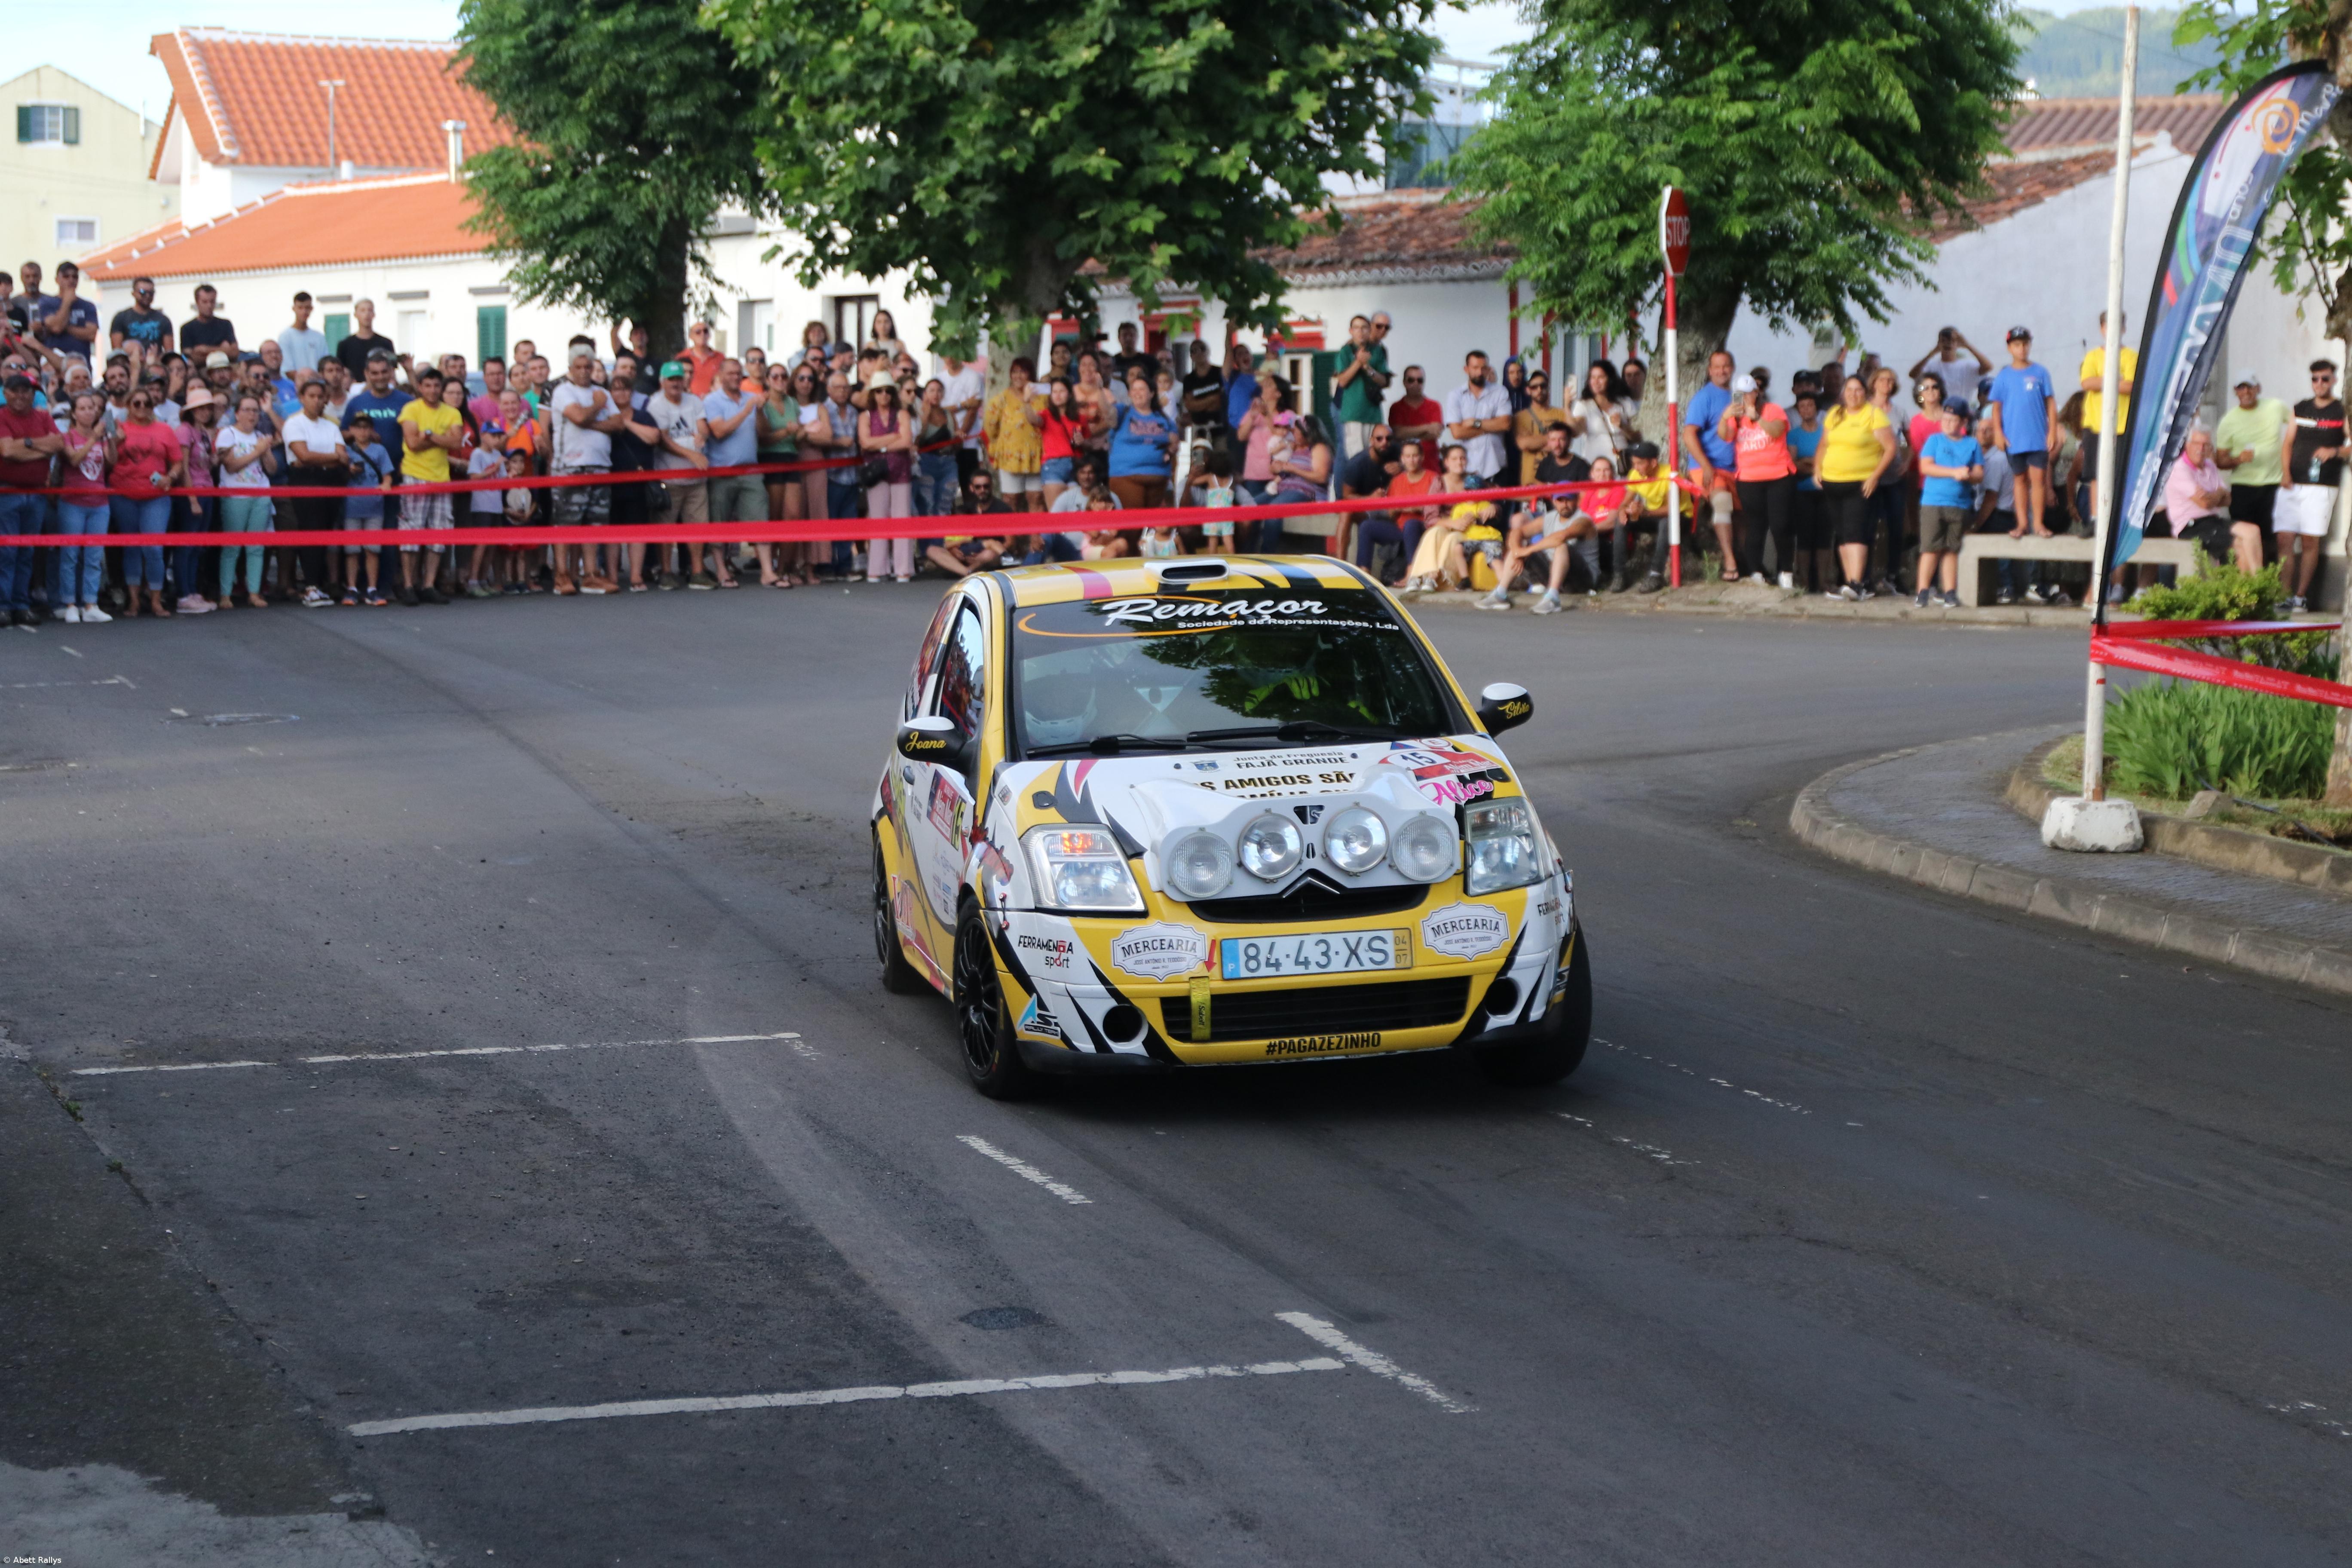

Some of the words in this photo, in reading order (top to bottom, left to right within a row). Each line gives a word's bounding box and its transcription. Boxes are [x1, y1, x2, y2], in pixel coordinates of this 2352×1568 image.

[1666, 216, 1690, 247] STOP
[1102, 598, 1328, 626] Remaçor
[1178, 619, 1245, 629] Sociedade
[1268, 618, 1372, 628] Representações,
[905, 731, 946, 752] Joana
[1236, 760, 1281, 769] FAJÃ
[1283, 757, 1350, 766] GRANDE
[1400, 752, 1437, 766] 15
[1195, 781, 1217, 791] S
[1225, 774, 1314, 790] AMIGOS
[1419, 780, 1494, 807] Alice
[1431, 919, 1500, 937] MERCEARIA
[1121, 938, 1197, 958] MERCEARIA
[1394, 935, 1407, 946] 04
[1395, 953, 1408, 964] 07
[1228, 964, 1235, 972] P
[1265, 1032, 1381, 1056] #PAGAZEZINHO
